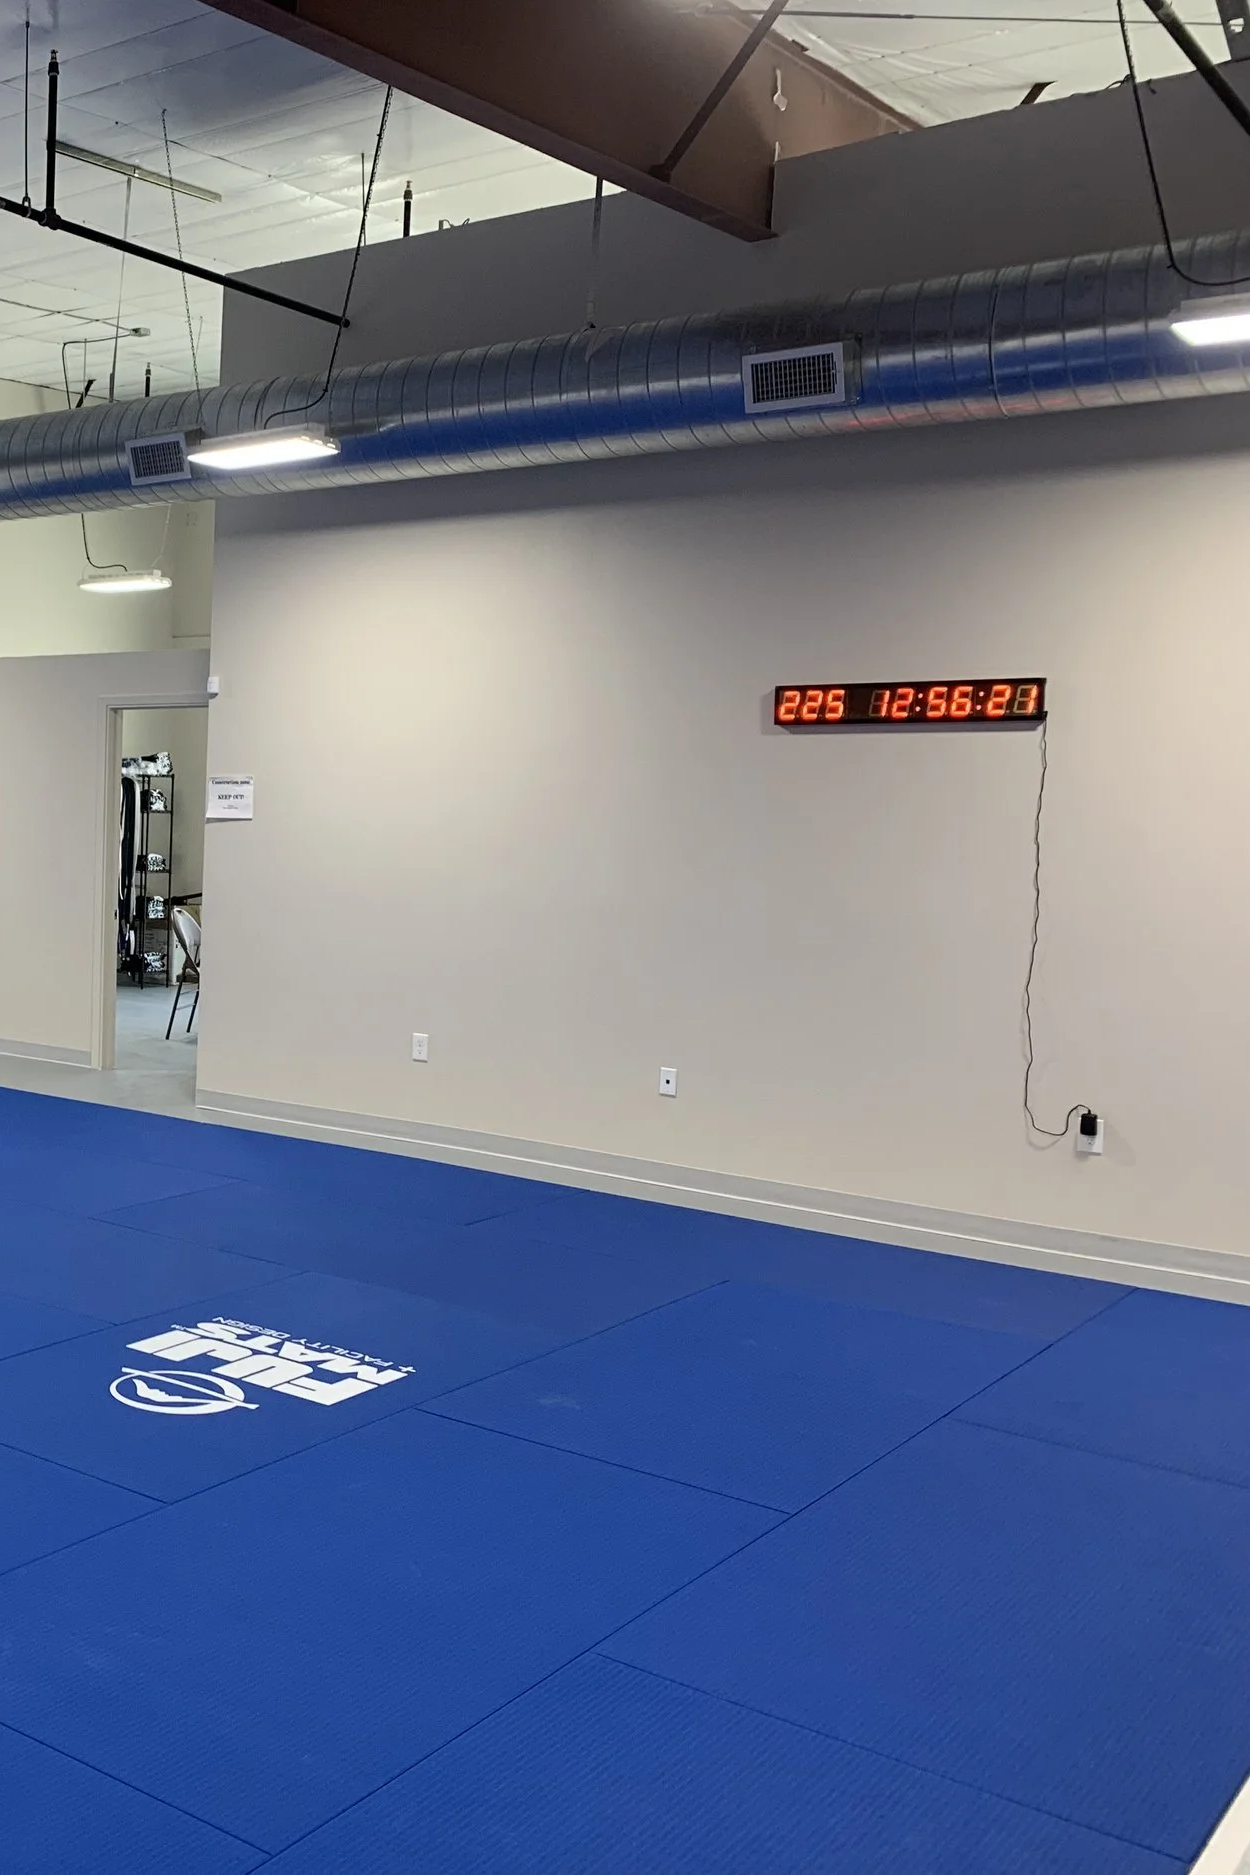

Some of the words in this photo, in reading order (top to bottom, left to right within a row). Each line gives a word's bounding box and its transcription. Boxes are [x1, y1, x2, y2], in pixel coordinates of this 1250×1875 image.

[779, 689, 846, 720] 225
[880, 684, 1039, 718] 12:56:21
[212, 1316, 291, 1339] DESIGN
[126, 1330, 379, 1406] FUJI
[186, 1322, 408, 1386] MATS
[291, 1338, 394, 1367] FACILITY
